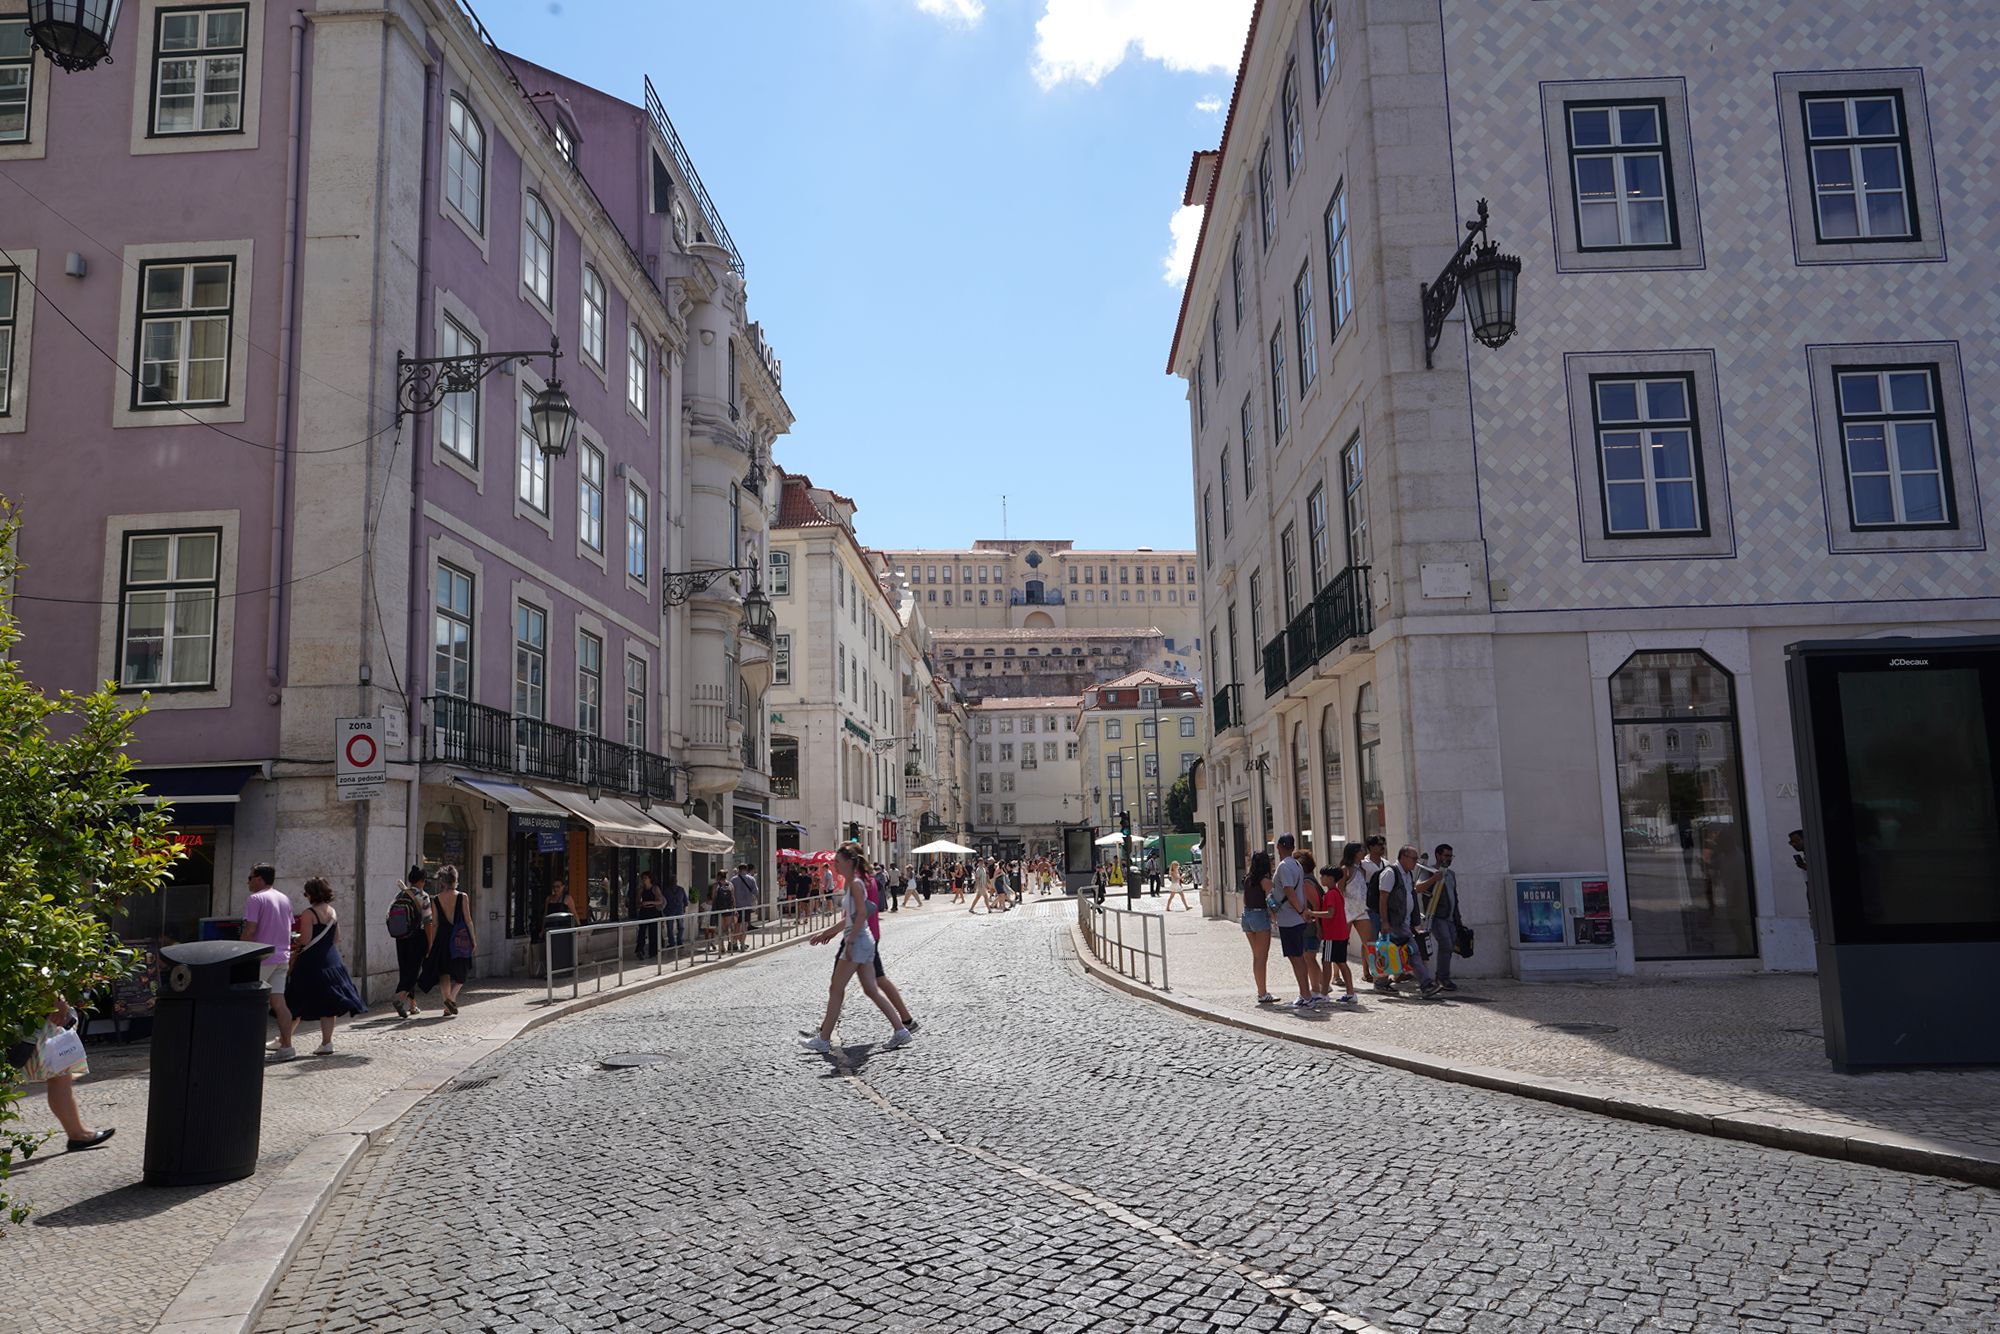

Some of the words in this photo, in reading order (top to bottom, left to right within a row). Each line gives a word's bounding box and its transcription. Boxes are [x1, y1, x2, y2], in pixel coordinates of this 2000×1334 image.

[1889, 658, 1928, 666] JCDecaux
[349, 722, 372, 730] zona
[357, 774, 384, 783] pedonal
[519, 816, 531, 826] DAMA
[174, 834, 202, 845] PIZZA
[1523, 891, 1555, 900] MOGWAI
